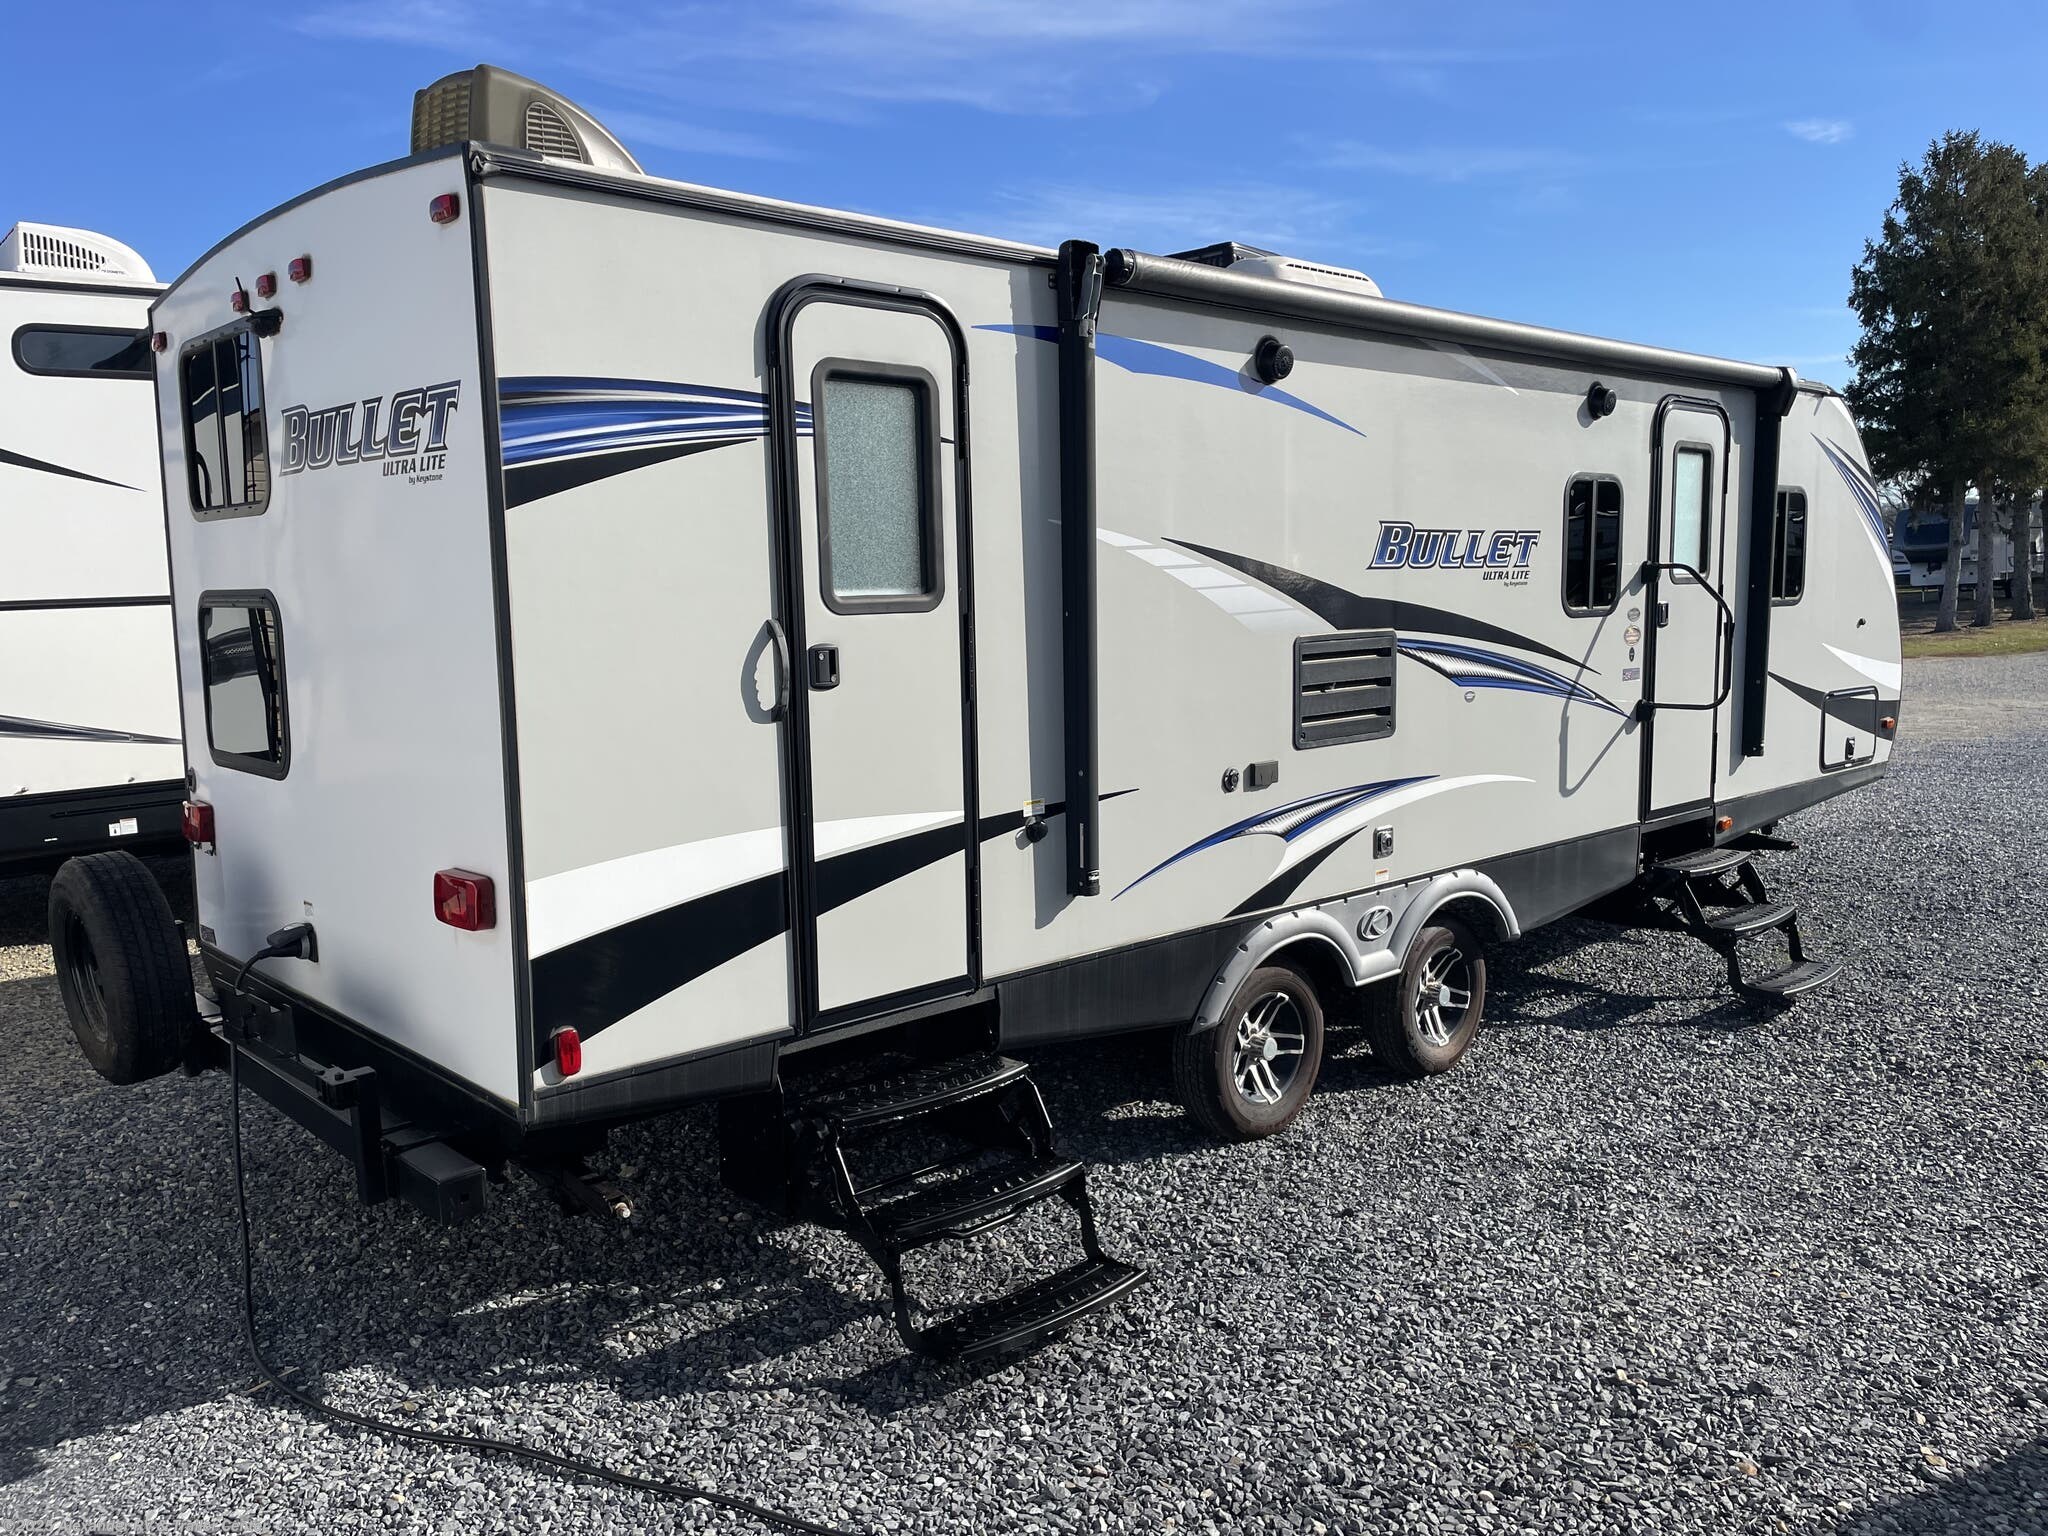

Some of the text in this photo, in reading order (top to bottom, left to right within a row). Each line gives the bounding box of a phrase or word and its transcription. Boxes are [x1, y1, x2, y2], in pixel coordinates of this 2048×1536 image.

[279, 379, 461, 477] BULLET
[382, 453, 446, 477] ULTRA LITE
[408, 474, 443, 485] by Keystone
[1366, 520, 1541, 570] BULLET
[1482, 570, 1530, 580] ULTRA LITE
